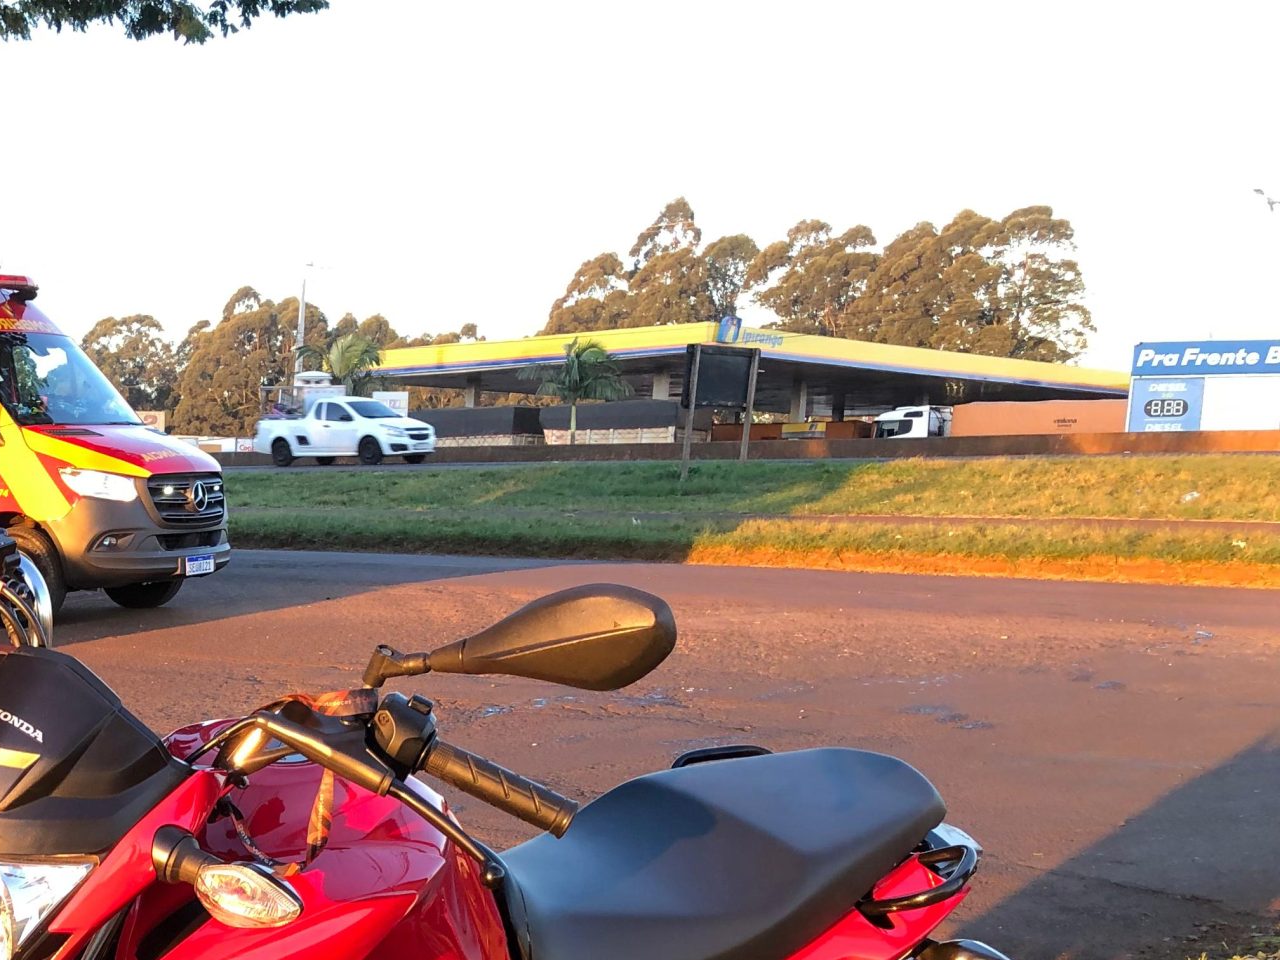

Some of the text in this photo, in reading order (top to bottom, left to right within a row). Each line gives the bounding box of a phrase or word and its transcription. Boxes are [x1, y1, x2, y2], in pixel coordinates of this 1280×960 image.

[1136, 349, 1180, 367] Pra
[1180, 347, 1260, 366] Frente
[1148, 382, 1188, 391] DIESEL
